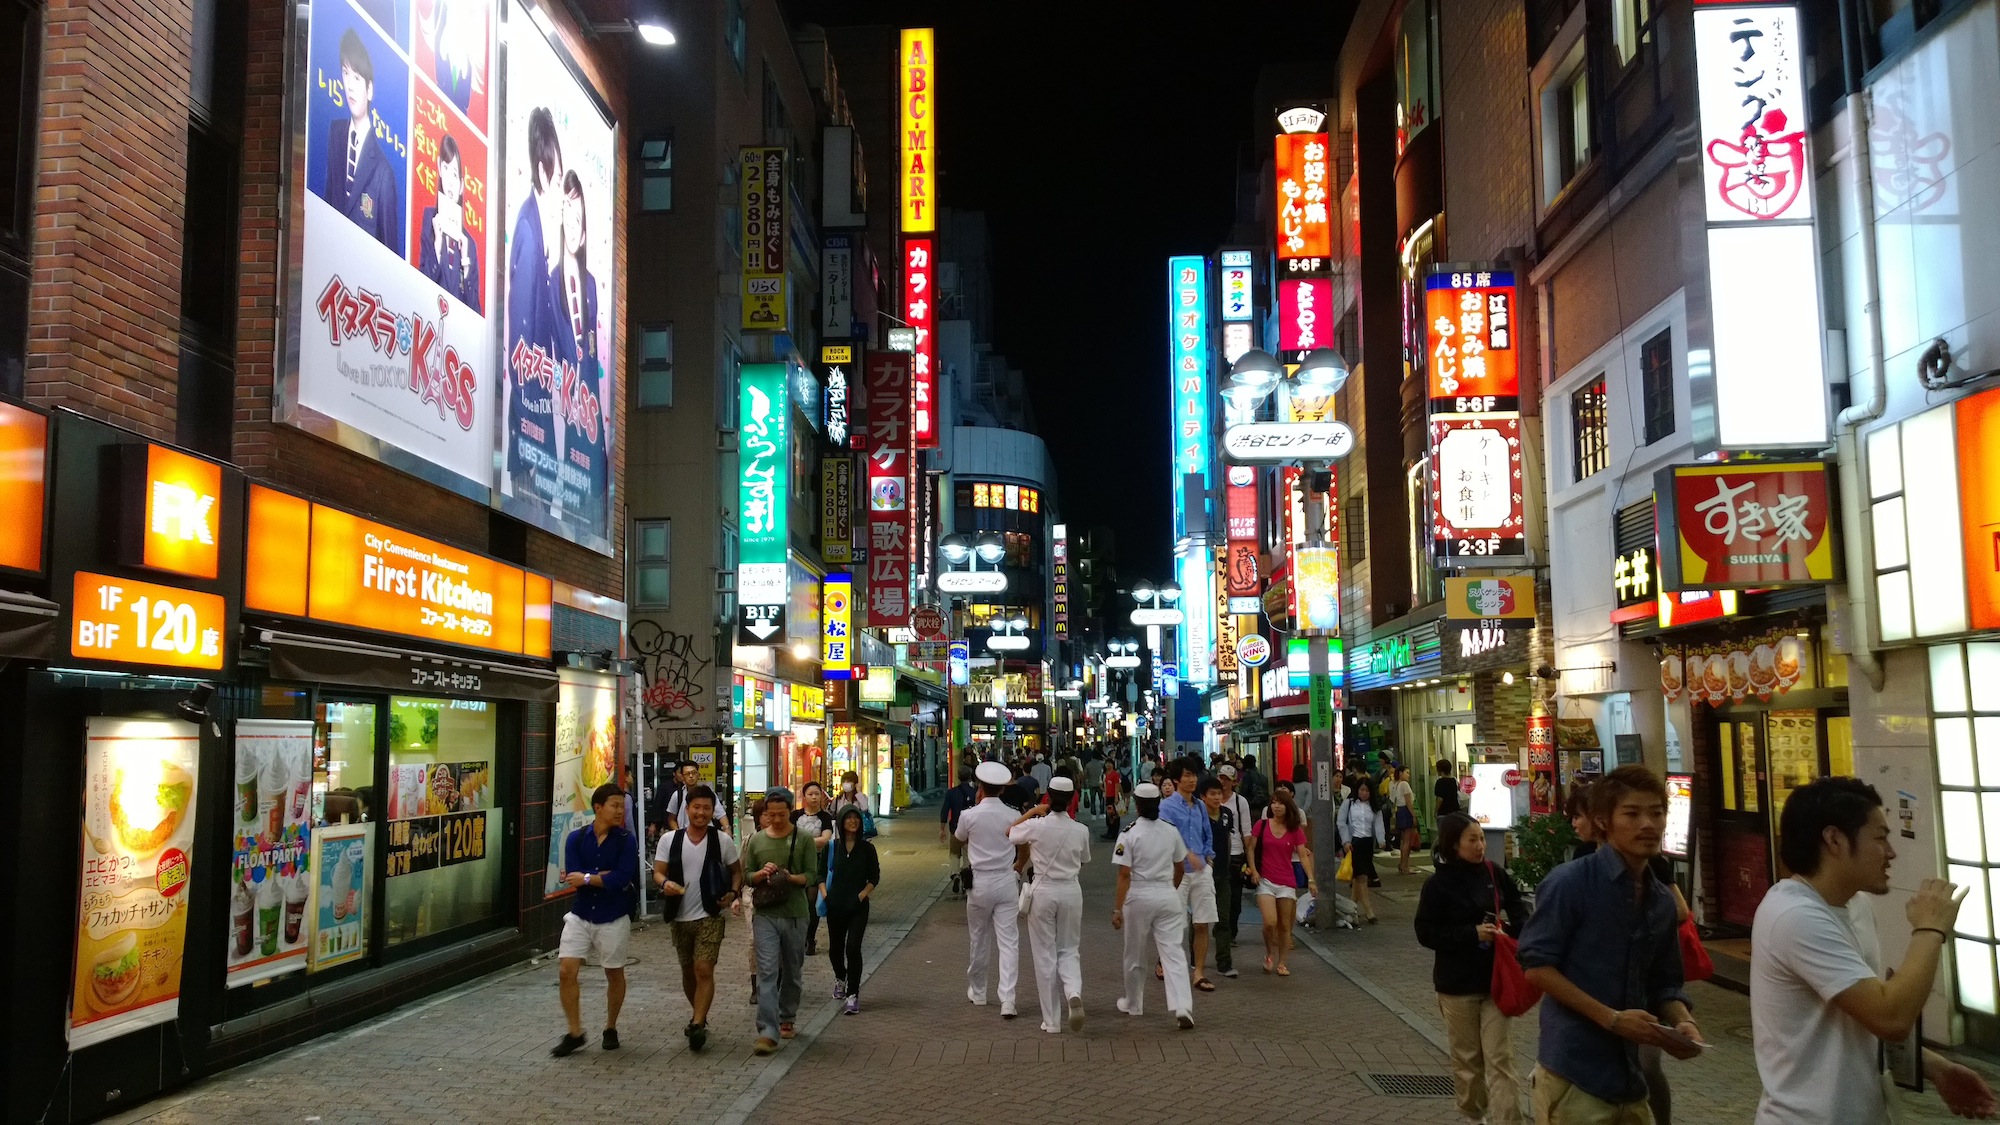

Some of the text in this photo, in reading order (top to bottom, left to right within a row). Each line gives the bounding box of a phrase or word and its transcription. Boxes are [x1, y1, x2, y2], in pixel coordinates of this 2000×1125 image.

[318, 67, 343, 107] いら
[1729, 18, 1783, 130] テング
[414, 124, 438, 161] 受け
[416, 162, 436, 195] くだ
[1303, 142, 1327, 223] お好み焼
[765, 153, 781, 270] 全身もみほぐし
[1282, 178, 1304, 252] もんじゃ
[825, 237, 848, 247] CBR
[751, 280, 778, 293] りらく
[828, 253, 839, 328] モニタールーム
[1230, 269, 1245, 313] カラオケ
[1460, 291, 1486, 379] お好み焼
[336, 351, 408, 390] Love in TOKYO
[1434, 315, 1460, 396] もんじゃ
[872, 361, 906, 470] カラオケ
[852, 435, 865, 447] 3F
[1231, 431, 1346, 448] 渋谷センター街
[151, 480, 216, 545] FK
[837, 463, 847, 540] 全身もみほぐし
[1458, 469, 1475, 522] お食事
[1694, 476, 1813, 550] すき家
[365, 533, 469, 575] City Convenience Restaurant
[852, 552, 867, 562] 2F
[872, 521, 906, 618] 歌広場
[1730, 554, 1783, 564] SUKIYA
[363, 555, 493, 616] First Kitchen
[1468, 587, 1512, 597] スパゲッティ
[1614, 548, 1650, 601] 牛丼
[98, 584, 123, 612] 1F
[745, 606, 780, 619] B1F
[78, 620, 121, 650] B1F
[826, 619, 847, 661] 松屋
[916, 617, 940, 629] 消火栓
[1480, 619, 1503, 629] B1F
[1242, 640, 1265, 651] BURGER
[1242, 644, 1266, 659] KING
[411, 669, 482, 691] ファースト キッチン
[412, 831, 439, 858] 合わせて
[444, 816, 485, 860] 120席
[238, 846, 303, 870] FLOAT PARTY
[83, 893, 112, 911] もちもち
[91, 897, 176, 929] フォカッチャサンド
